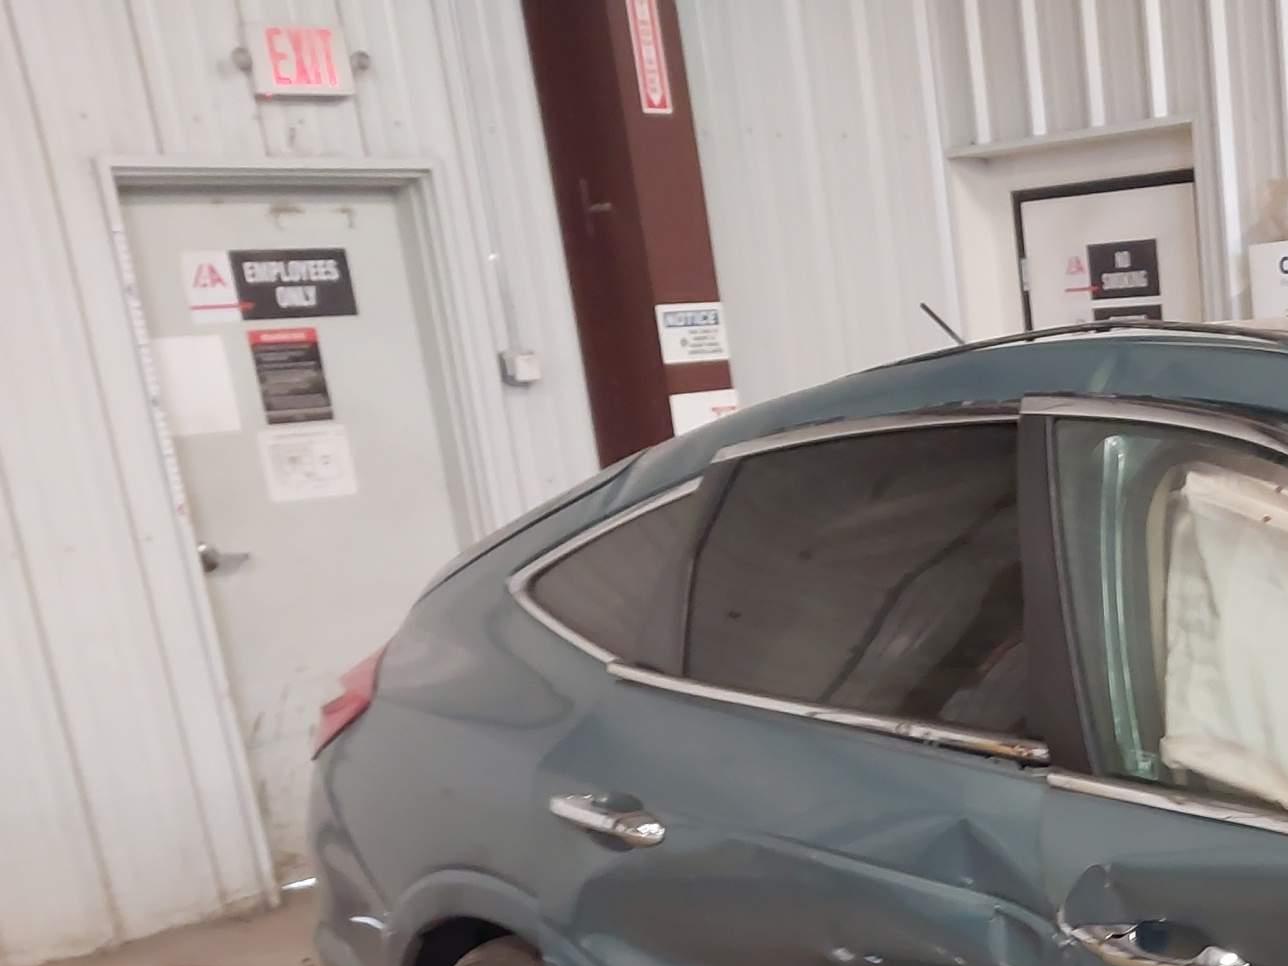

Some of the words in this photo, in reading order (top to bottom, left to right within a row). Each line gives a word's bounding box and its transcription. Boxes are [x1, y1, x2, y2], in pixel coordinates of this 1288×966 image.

[265, 28, 337, 86] EXIT
[1115, 251, 1131, 269] NO
[242, 260, 340, 283] EMPLOYEES
[275, 286, 317, 308] ONLY
[665, 310, 720, 327] NOTICE
